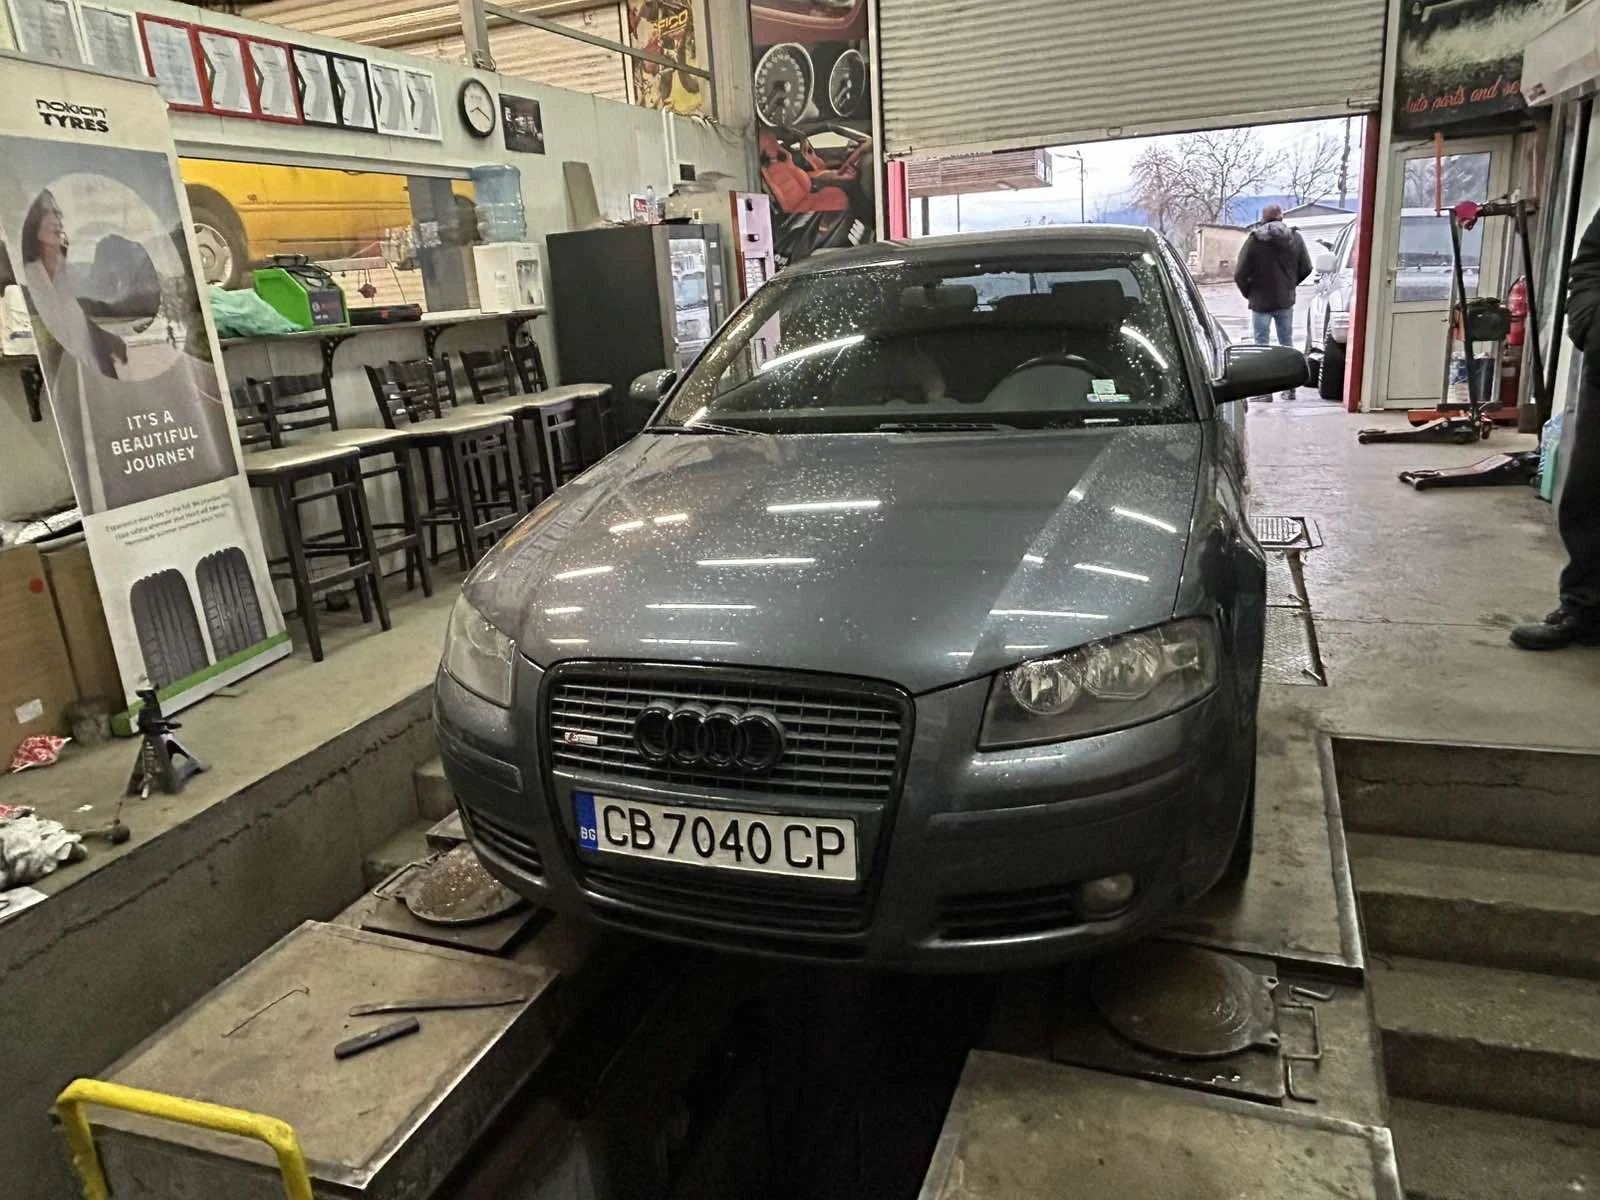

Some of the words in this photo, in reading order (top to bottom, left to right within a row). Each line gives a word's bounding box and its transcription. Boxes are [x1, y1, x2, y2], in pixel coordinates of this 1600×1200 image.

[1471, 74, 1502, 101] and
[1503, 79, 1522, 97] se
[36, 99, 106, 118] nokian
[39, 111, 109, 133] TYRES
[126, 412, 158, 431] IT'S
[163, 410, 174, 424] A
[111, 426, 198, 456] BEAUTIFUL
[123, 446, 195, 474] JOURNEY
[580, 826, 597, 841] BG
[603, 804, 656, 850] CB
[662, 812, 772, 865] 7040
[783, 823, 846, 871] CP
